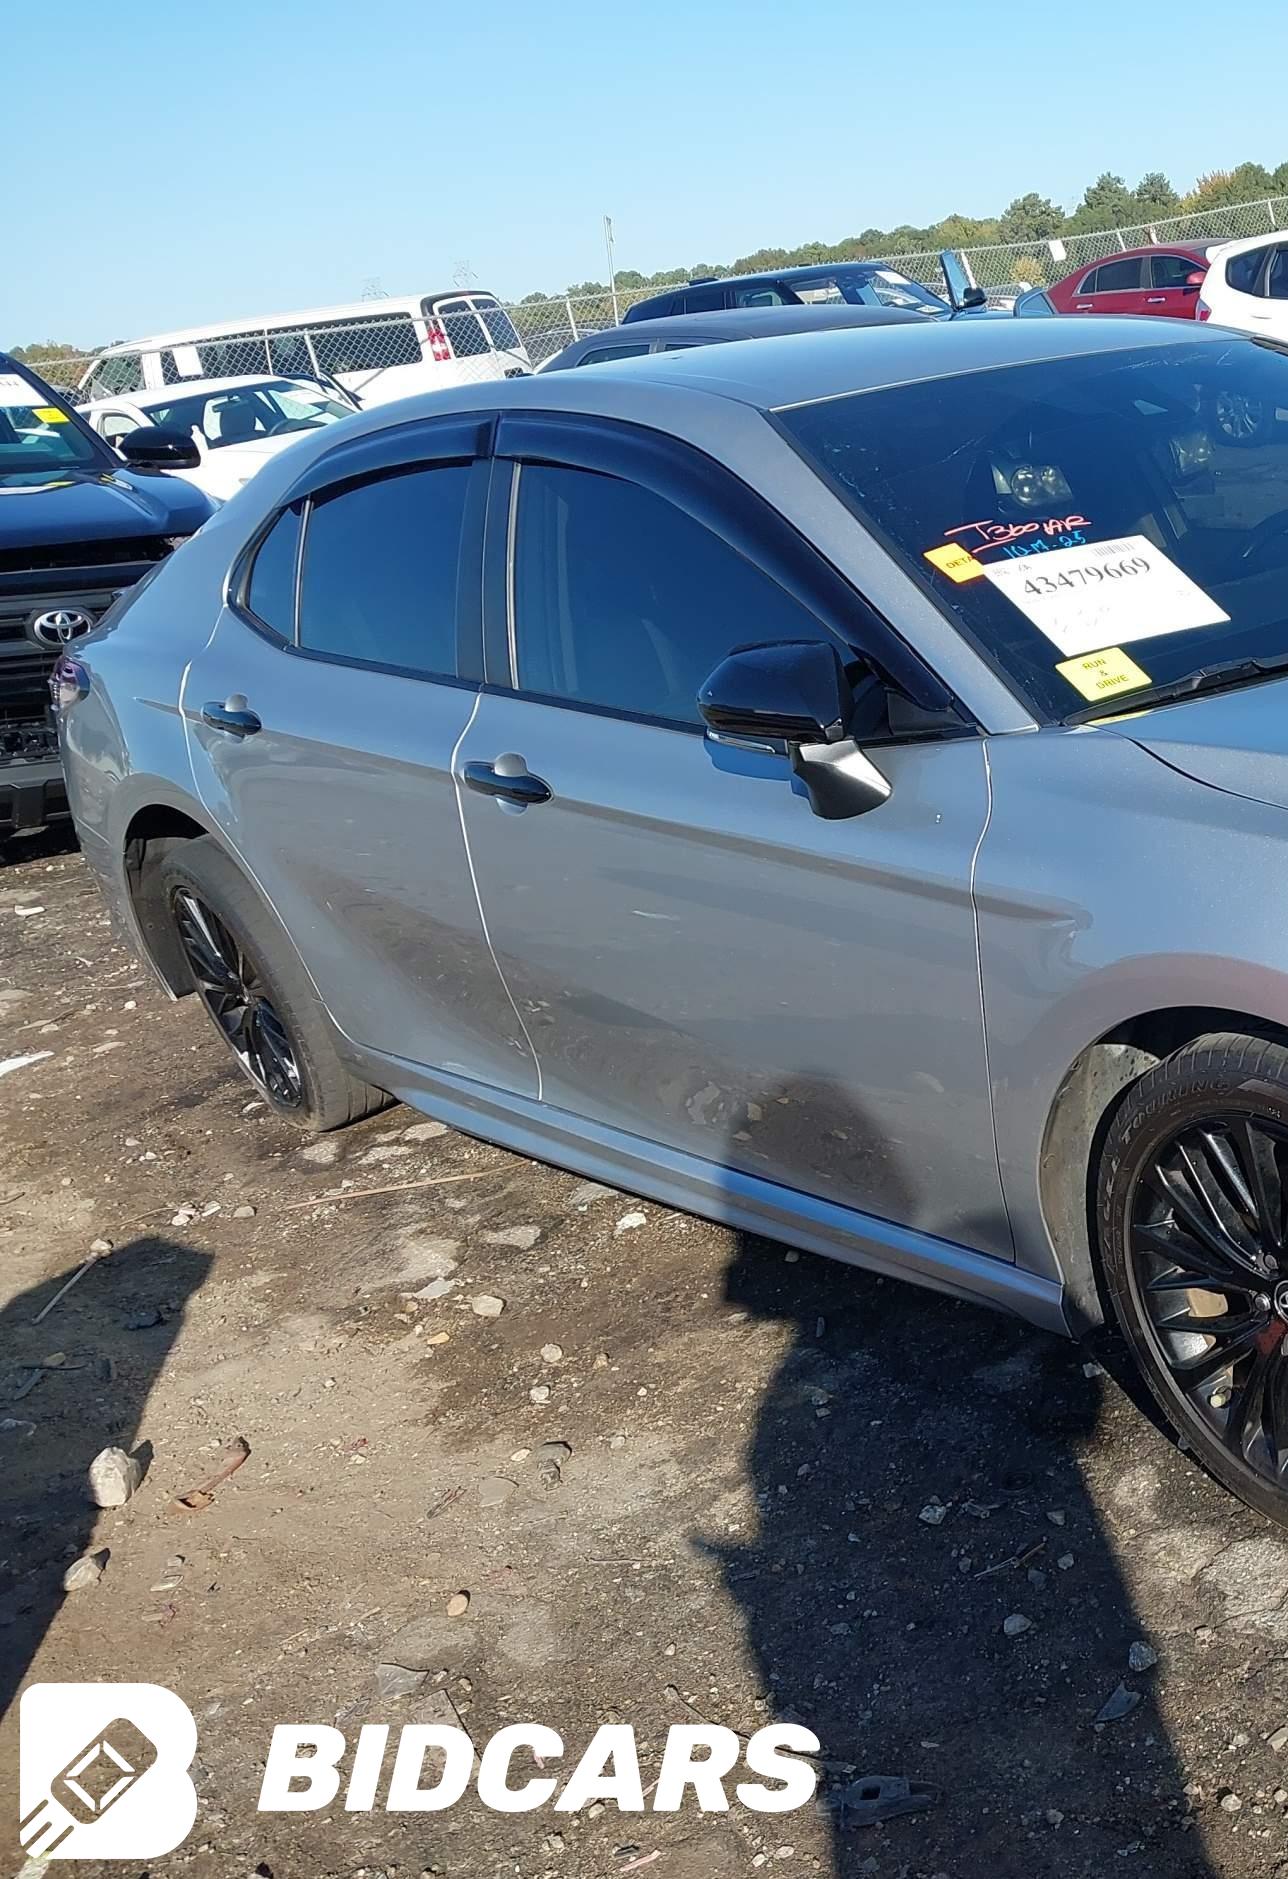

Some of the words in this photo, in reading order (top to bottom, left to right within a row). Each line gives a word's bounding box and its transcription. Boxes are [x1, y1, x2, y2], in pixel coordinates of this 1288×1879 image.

[1024, 557, 1151, 595] 43479669
[1082, 658, 1107, 670] RUN
[1095, 674, 1129, 690] DRIVE
